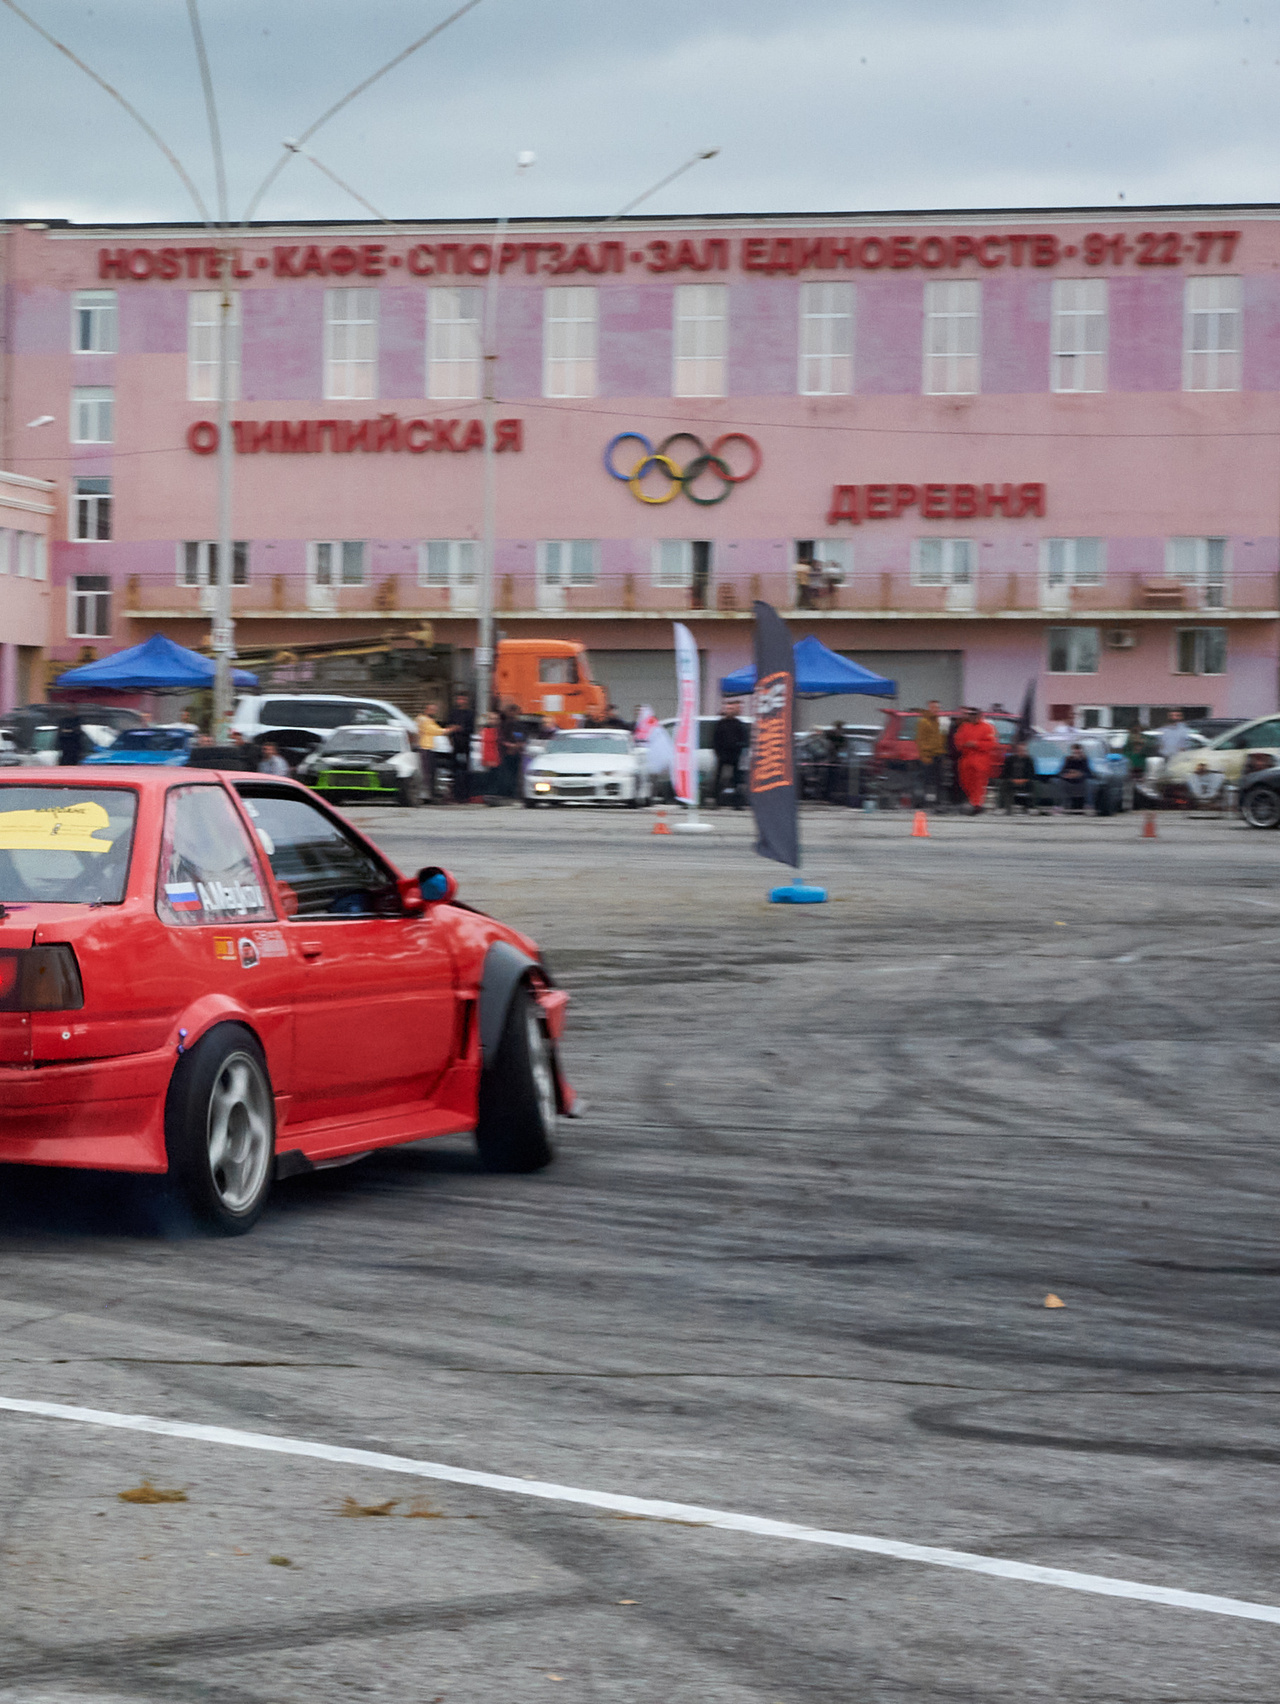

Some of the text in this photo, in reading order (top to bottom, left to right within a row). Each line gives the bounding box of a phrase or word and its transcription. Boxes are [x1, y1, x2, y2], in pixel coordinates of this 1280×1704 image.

[99, 247, 252, 279] HOSTEL
[273, 245, 387, 277] КАФЕ
[408, 241, 626, 276] СПОРТЗАЛ
[1083, 229, 1243, 267] 91-22-77
[826, 483, 1047, 526] ДЕРЕВНЯ
